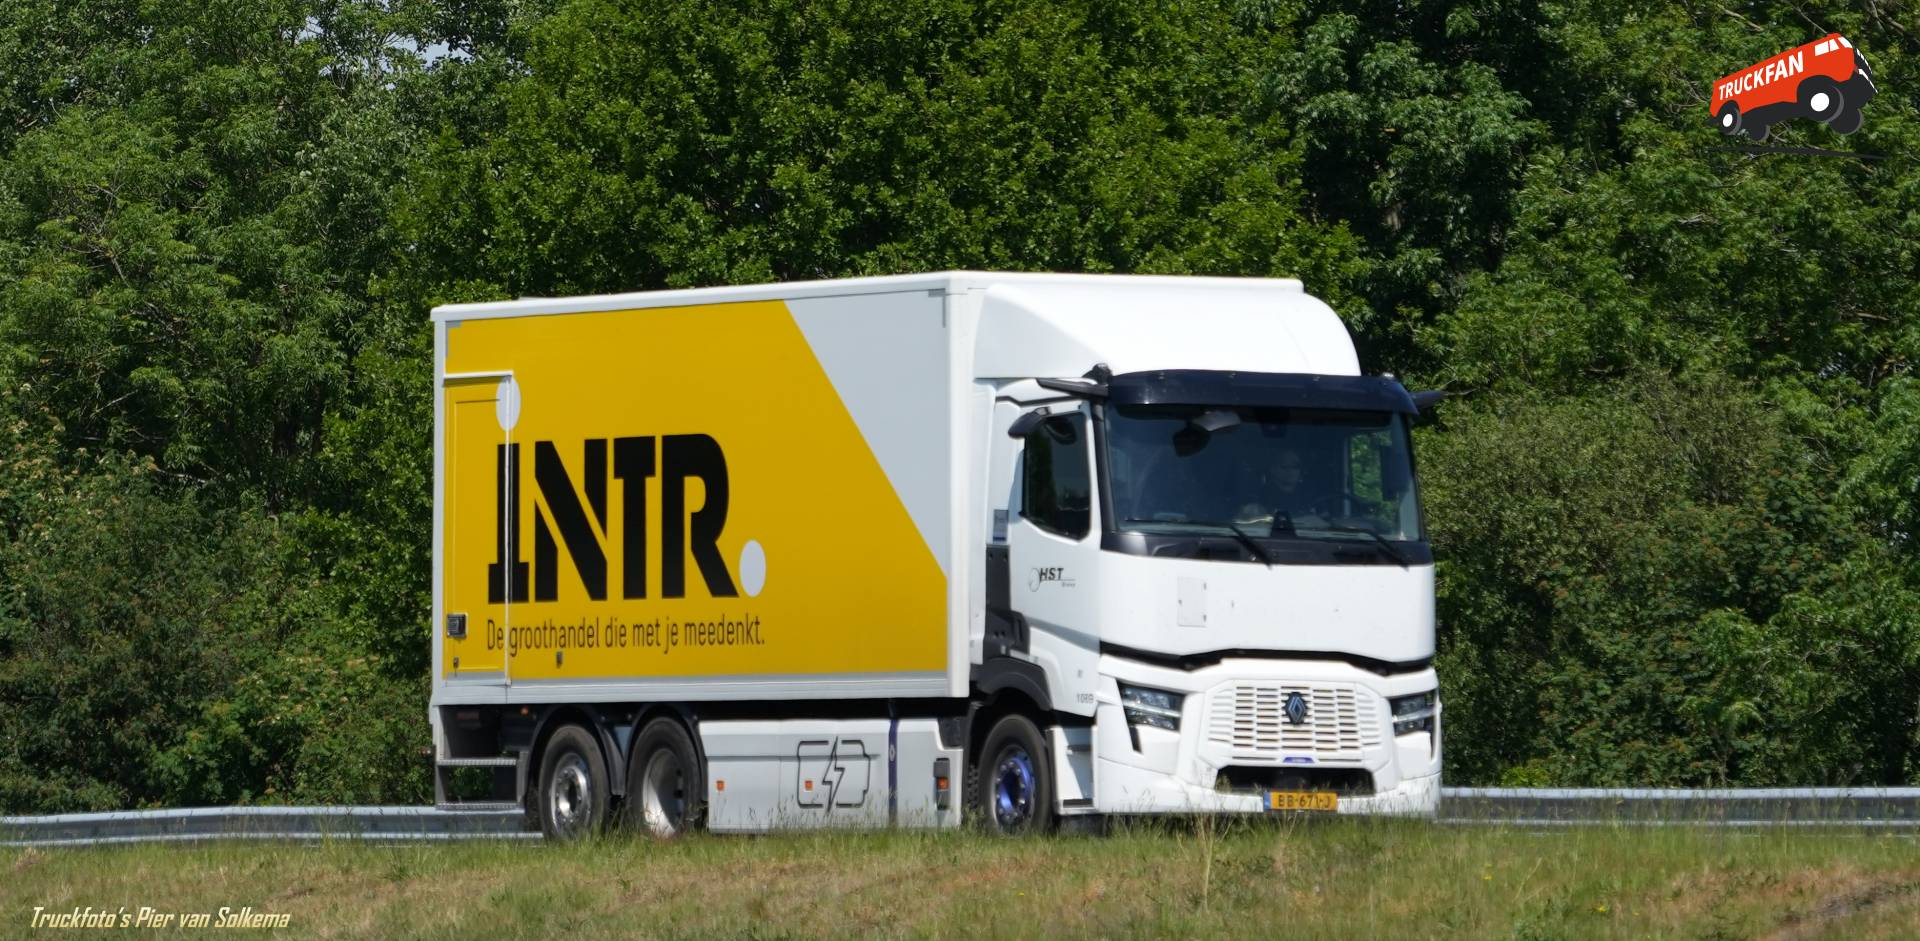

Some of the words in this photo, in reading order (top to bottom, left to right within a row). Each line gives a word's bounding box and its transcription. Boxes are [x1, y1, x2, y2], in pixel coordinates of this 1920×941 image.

[1040, 567, 1064, 581] HST
[487, 619, 504, 650] De
[510, 616, 600, 657] groothandel
[605, 617, 627, 648] die
[632, 618, 661, 647] met
[664, 616, 679, 654] je
[684, 613, 765, 647] meedenkt.
